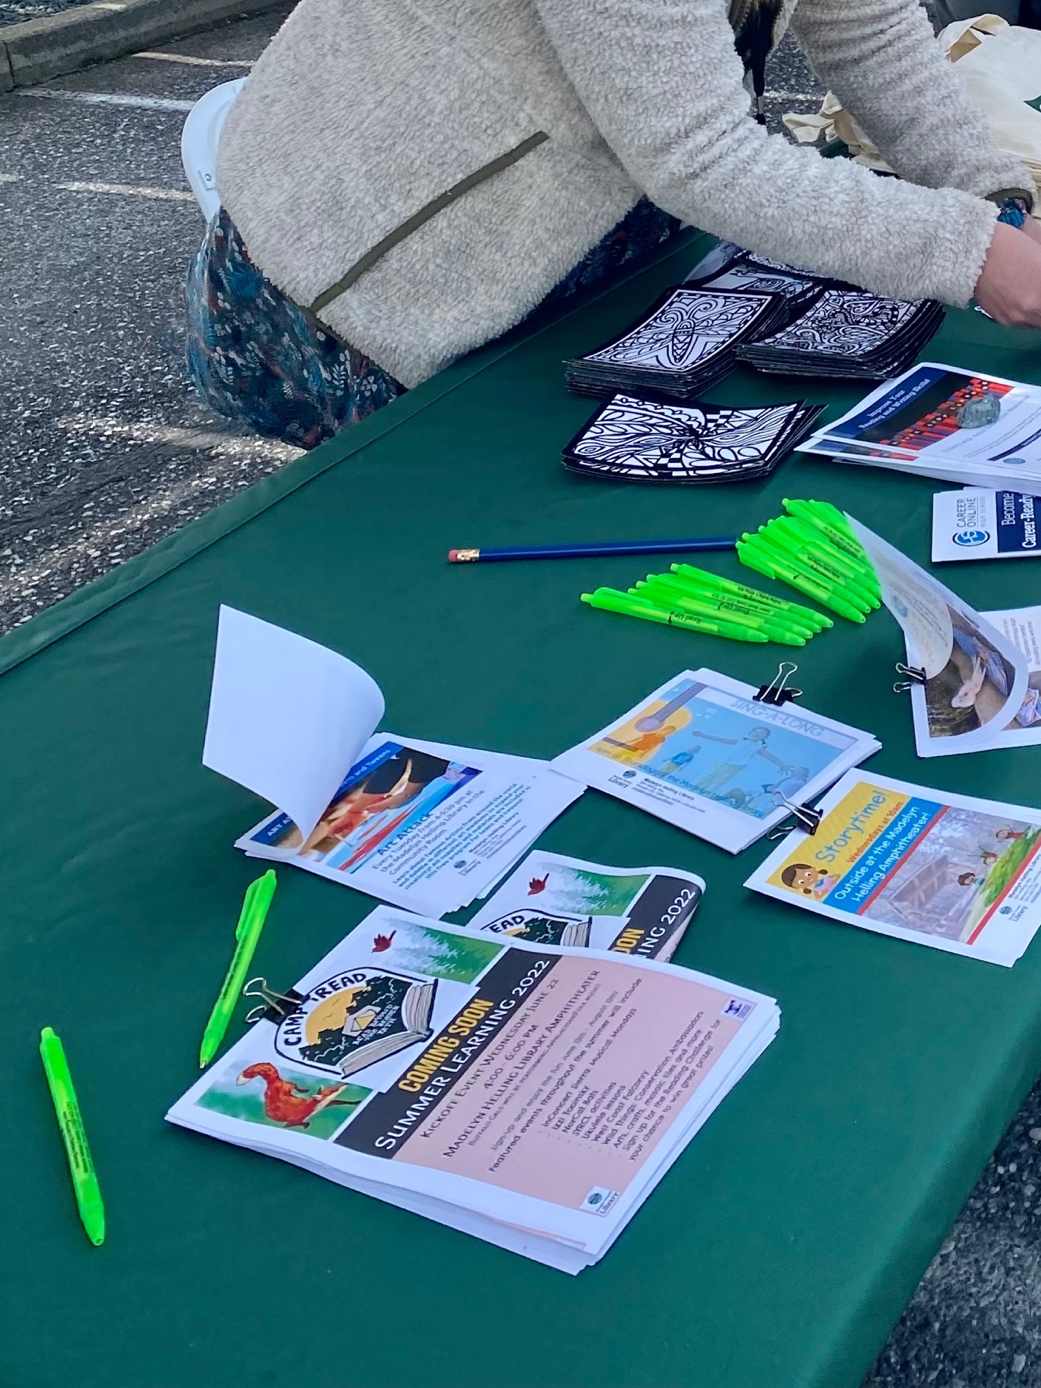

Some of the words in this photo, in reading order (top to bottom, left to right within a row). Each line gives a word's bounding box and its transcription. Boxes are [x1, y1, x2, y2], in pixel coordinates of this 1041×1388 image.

[956, 498, 966, 527] CAREER
[966, 497, 976, 527] ONLINE
[1001, 492, 1015, 525] Become
[728, 699, 827, 737] SING-A-LONG
[374, 839, 398, 855] Art
[392, 811, 434, 840] Attack
[812, 789, 896, 865] Storytime!
[883, 805, 923, 840] Madelyn
[387, 844, 429, 875] Community
[389, 832, 421, 854] Tuesday
[845, 824, 885, 863] Wednesdays
[849, 870, 887, 903] Helling
[875, 811, 935, 872] Amphitheater!
[863, 855, 879, 866] at
[870, 839, 891, 855] the
[832, 865, 870, 900] Outside
[488, 914, 526, 934] EAD
[660, 888, 696, 924] 2022
[509, 959, 552, 996] 2022
[395, 1036, 462, 1092] COMING
[445, 998, 495, 1036] SOON
[453, 1068, 486, 1097] EVENT
[478, 1012, 534, 1067] WEDNESDAY
[545, 978, 560, 989] 22
[480, 1067, 507, 1089] 4:00
[502, 1039, 528, 1060] 6:00
[522, 1024, 539, 1038] PM
[640, 1080, 668, 1105] mosaic
[672, 1048, 689, 1062] and
[684, 1029, 704, 1047] more
[442, 1112, 488, 1157] MADELYN
[480, 1071, 521, 1109] HELLING
[513, 1033, 551, 1069] LIBRARY
[485, 1135, 524, 1172] Featured
[516, 1107, 545, 1133] events
[536, 1063, 580, 1105] throughout
[571, 1049, 588, 1061] the
[581, 1019, 612, 1048] summer
[586, 1081, 619, 1113] activities
[602, 1084, 628, 1110] lessons
[639, 1114, 667, 1141] chance
[668, 1089, 683, 1103] win
[678, 1069, 701, 1088] great
[589, 1124, 610, 1142] West
[604, 1101, 628, 1123] Coast
